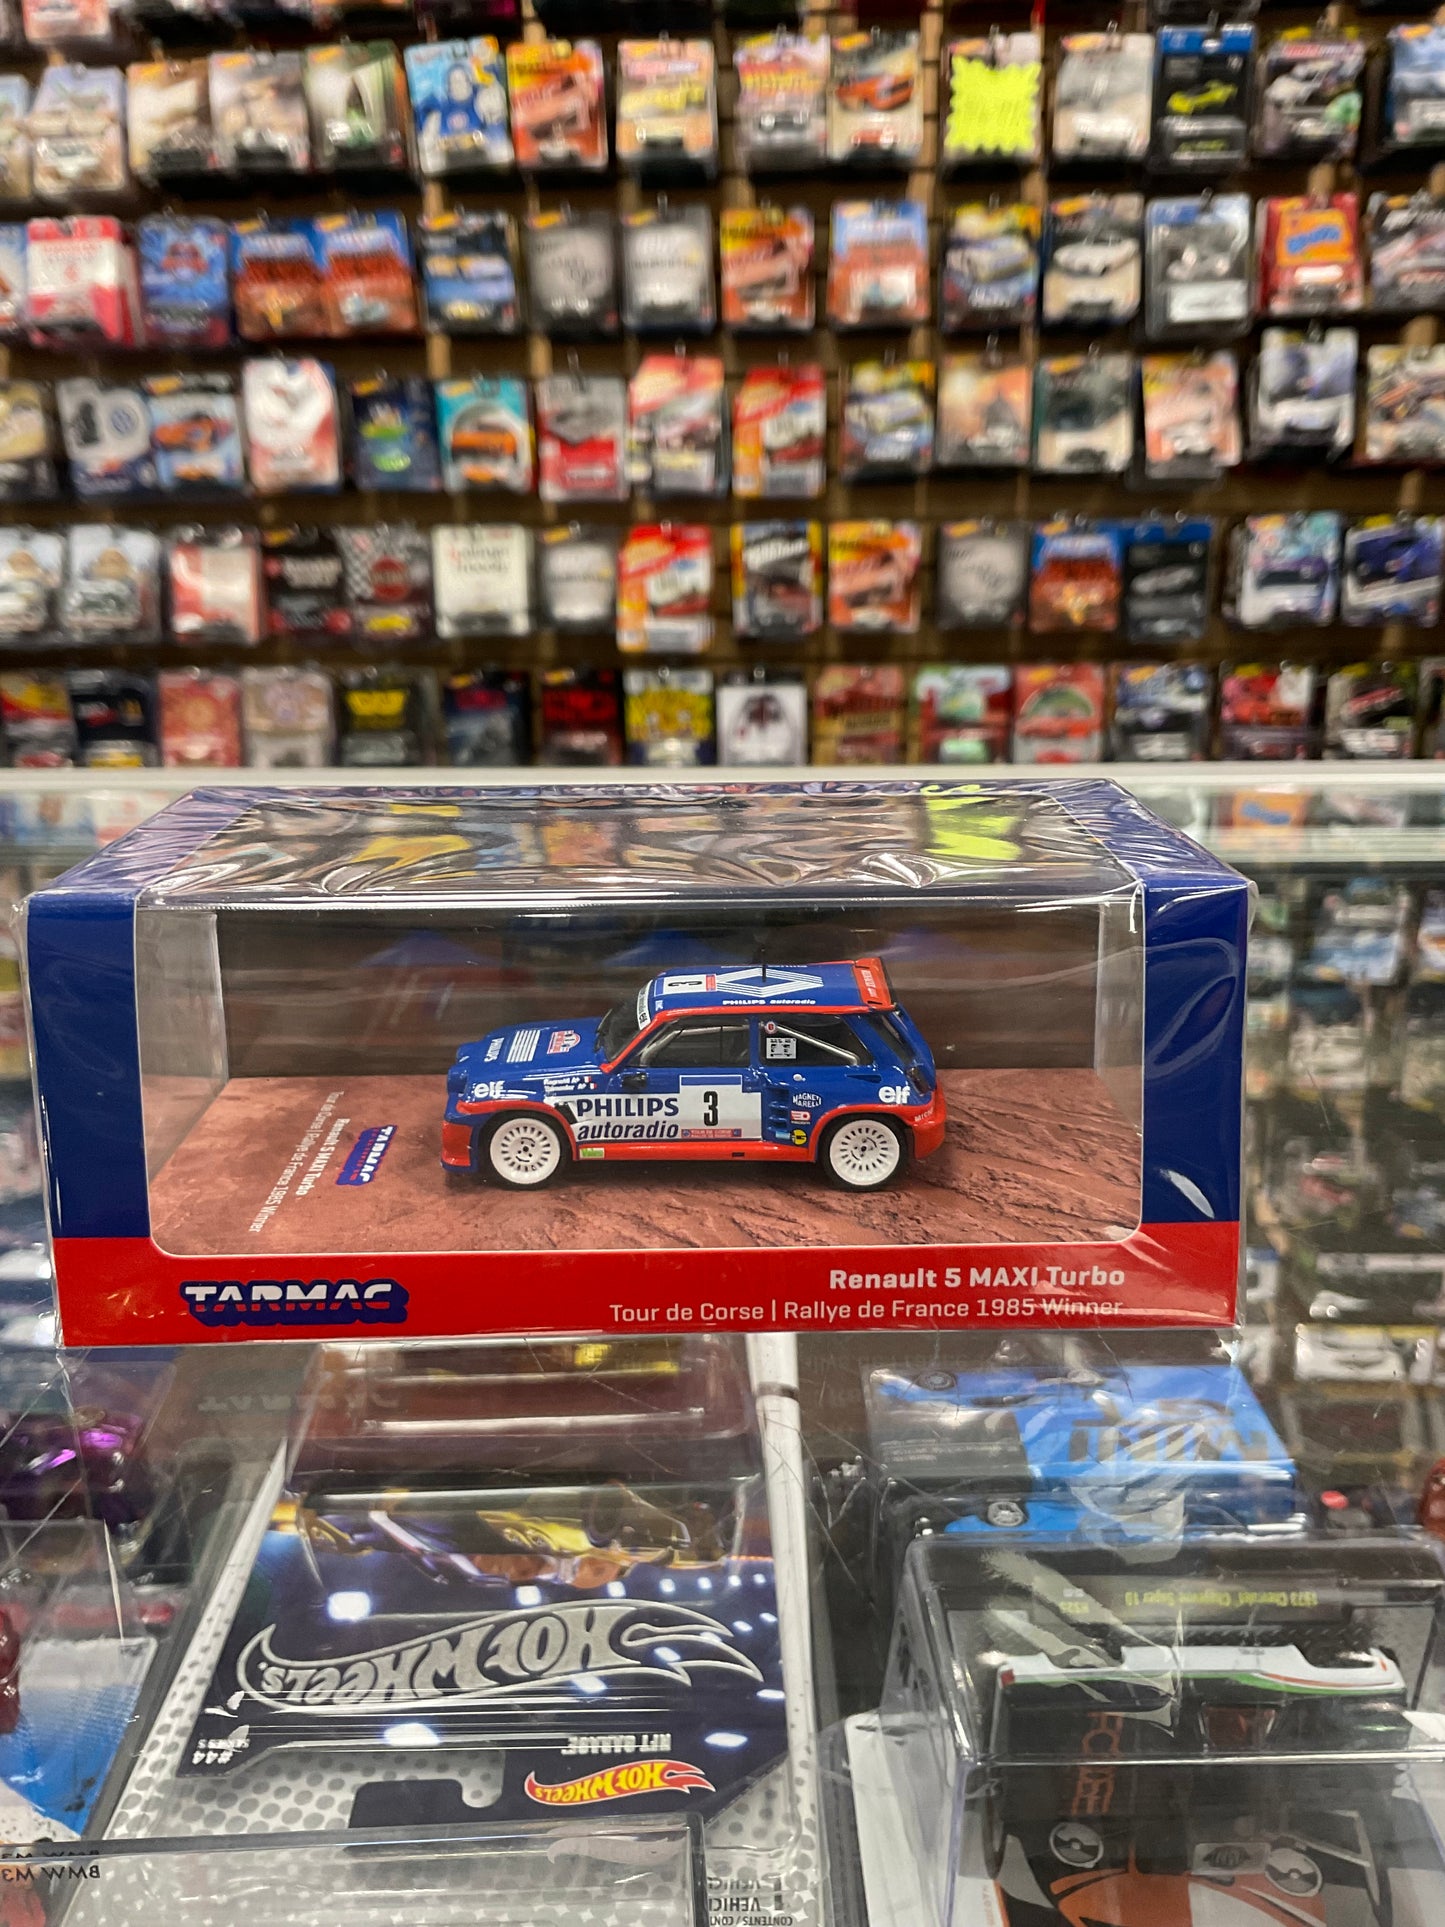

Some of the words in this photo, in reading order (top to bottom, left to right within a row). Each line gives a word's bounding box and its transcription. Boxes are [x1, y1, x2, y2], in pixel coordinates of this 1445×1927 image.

[473, 1080, 505, 1099] elf
[878, 1081, 911, 1106] elf
[576, 1097, 680, 1118] PHILIPS
[703, 1090, 719, 1126] 3
[577, 1119, 680, 1140] autoradio
[830, 1268, 938, 1289] Renault
[944, 1268, 961, 1288] 5
[969, 1266, 1038, 1287] MAXI
[1046, 1265, 1126, 1286] Turbo
[185, 1283, 393, 1313] TARMAC
[609, 1304, 660, 1322] Tour
[666, 1303, 693, 1321] de
[700, 1303, 765, 1321] Corse
[784, 1301, 851, 1323] Rallye
[858, 1300, 885, 1319] de
[892, 1300, 969, 1318] France
[976, 1298, 1035, 1317] 1985
[1041, 1298, 1124, 1316] Winner
[742, 1916, 794, 1927] CONTENTS
